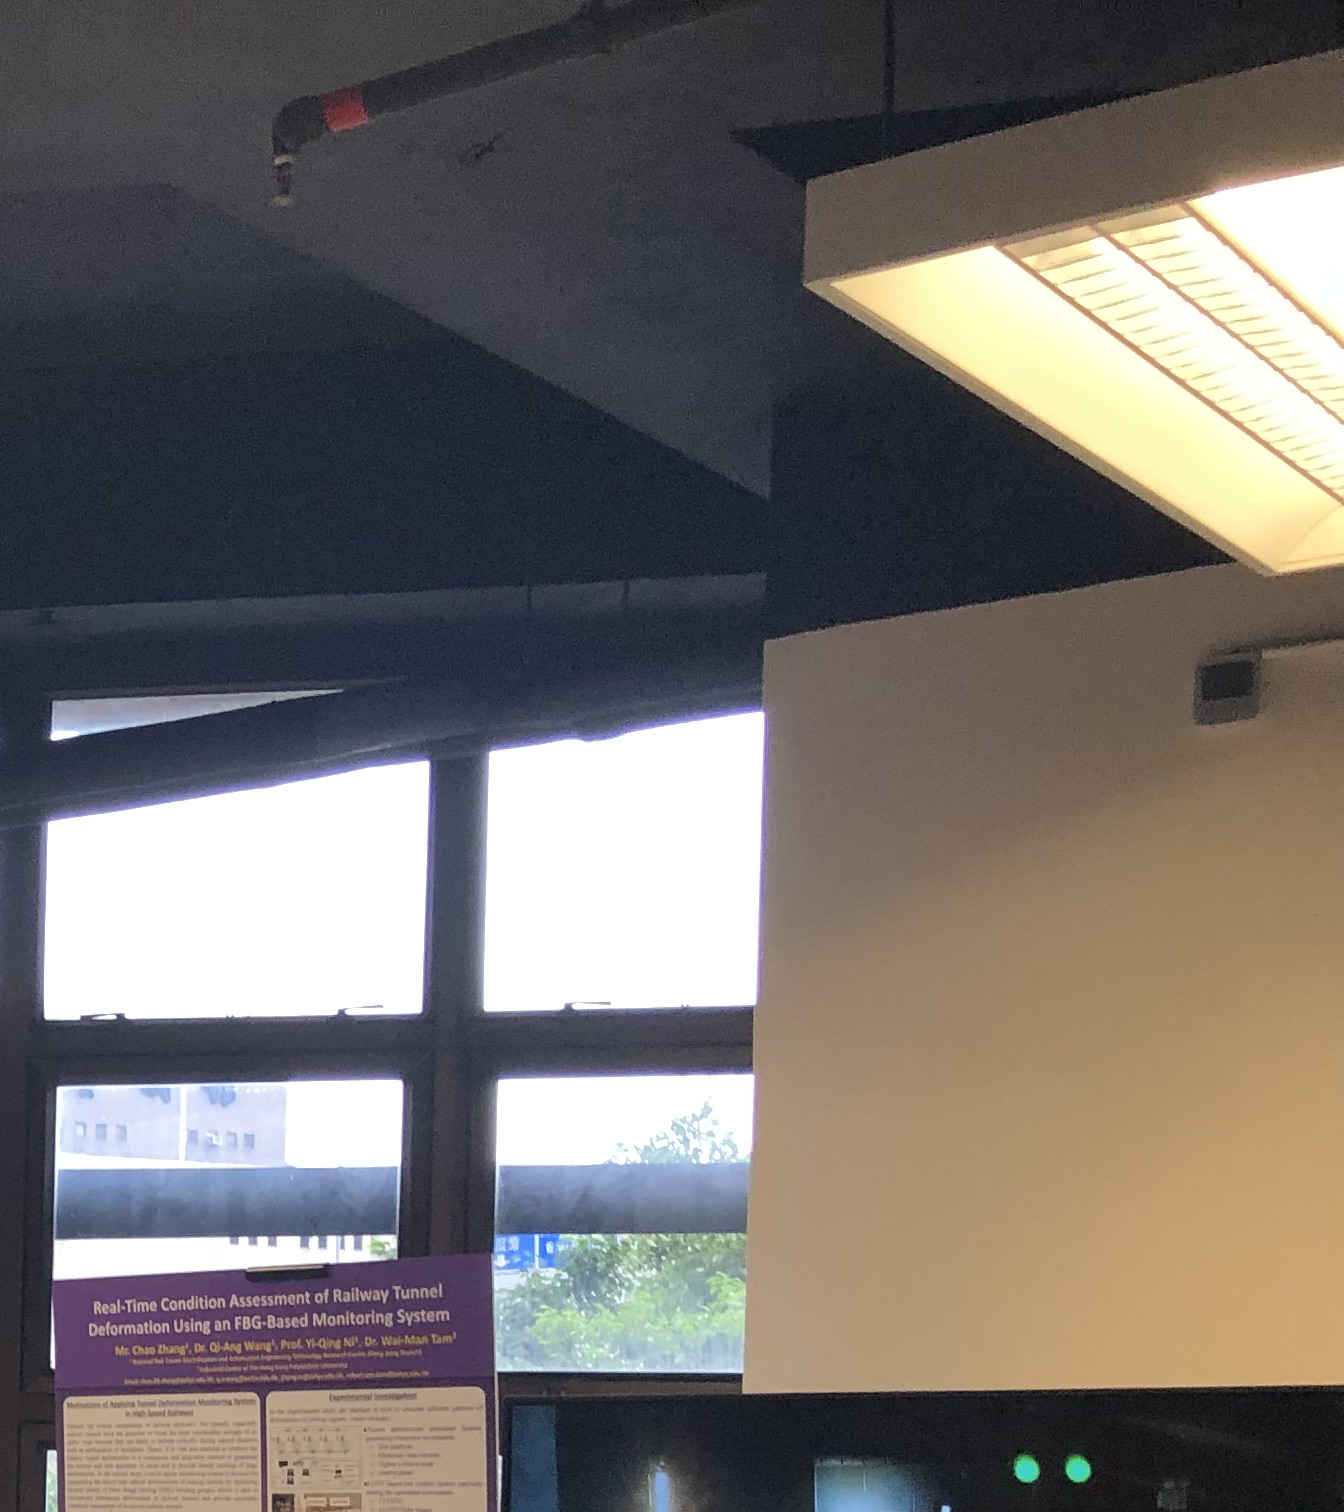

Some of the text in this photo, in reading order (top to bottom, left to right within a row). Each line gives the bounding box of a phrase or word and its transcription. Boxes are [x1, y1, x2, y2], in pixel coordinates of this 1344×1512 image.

[93, 1282, 443, 1315] Real-Time Condition Assessment of Railway Tunnel
[88, 1308, 451, 1337] Deformation Using an FBG-Based Monitoring System
